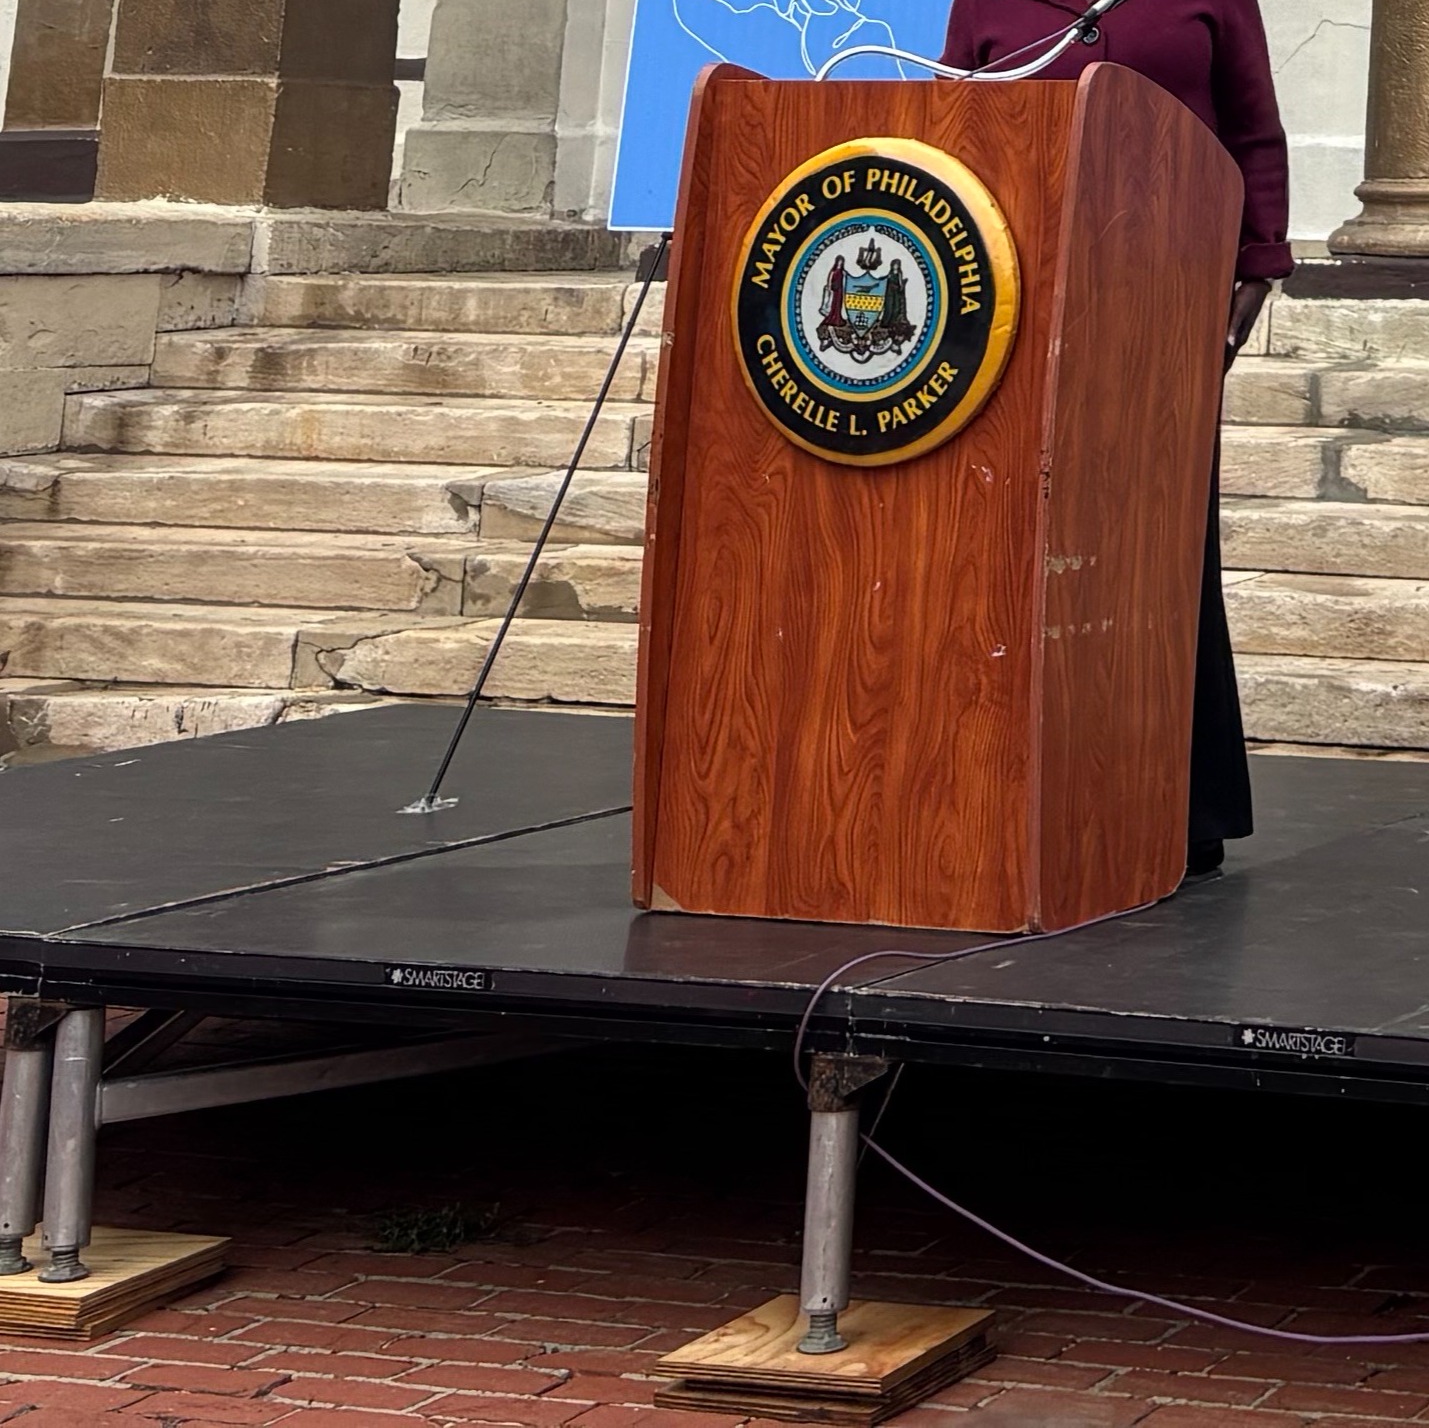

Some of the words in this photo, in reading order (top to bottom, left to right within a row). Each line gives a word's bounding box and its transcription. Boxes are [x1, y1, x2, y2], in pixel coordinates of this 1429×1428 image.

[751, 192, 816, 290] MAYOR
[821, 169, 857, 201] OF
[865, 167, 983, 316] PHILADELPHIA
[755, 333, 841, 433] CHERELLE
[848, 413, 868, 436] L.
[876, 359, 960, 434] PARKER
[1254, 1028, 1346, 1055] SMARTSTAGE
